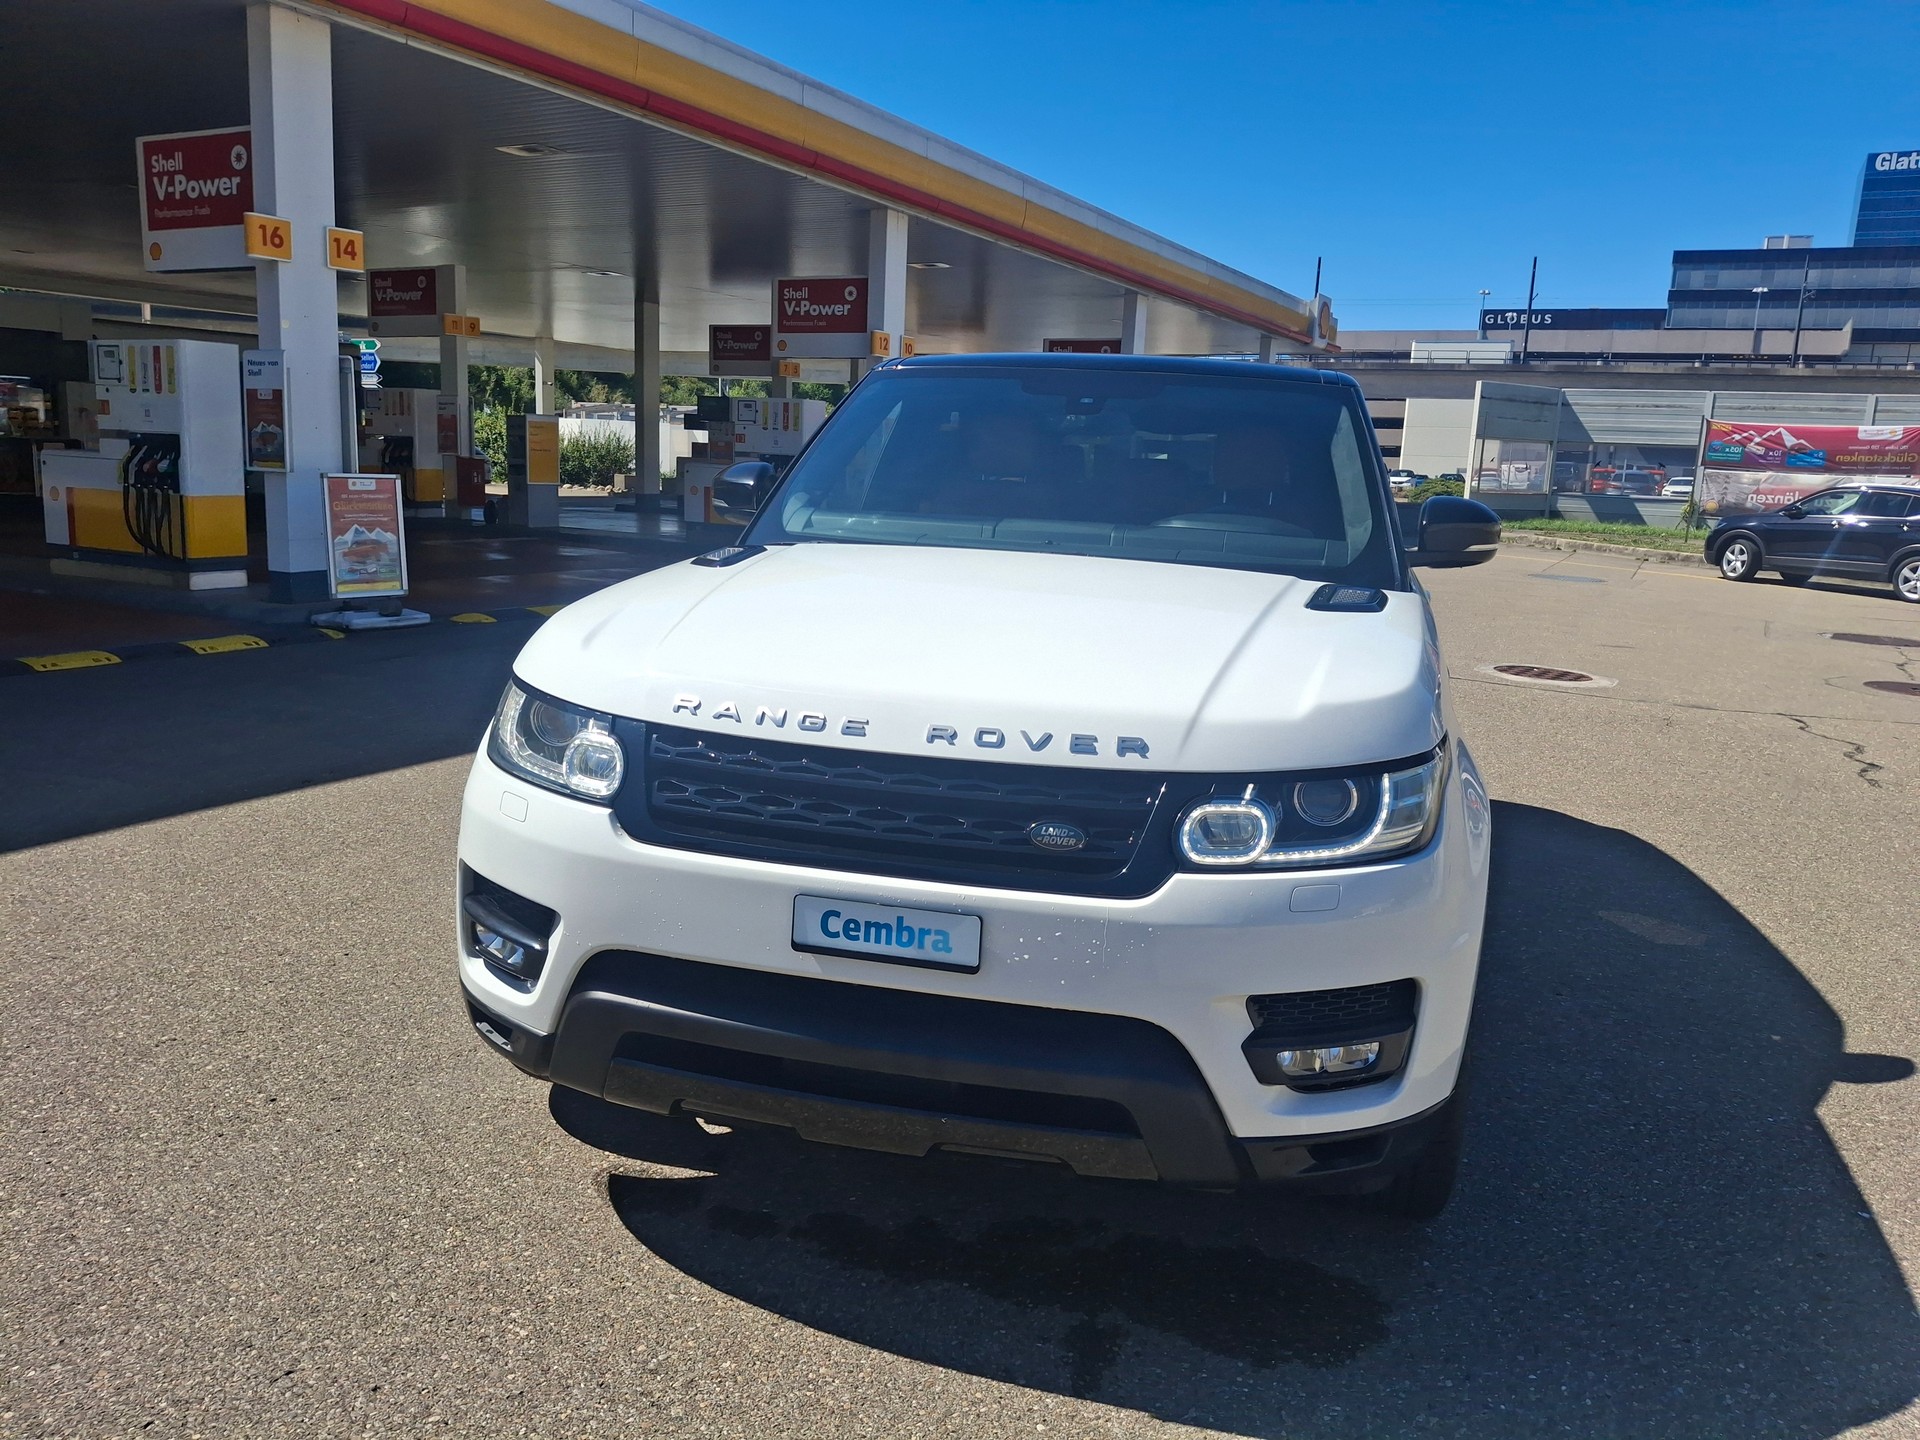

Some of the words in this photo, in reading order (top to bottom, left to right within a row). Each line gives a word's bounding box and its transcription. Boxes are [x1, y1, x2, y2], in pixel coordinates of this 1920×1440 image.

[151, 152, 183, 174] Shell
[1875, 152, 1920, 171] Glat
[152, 174, 241, 201] V-Power
[258, 223, 285, 249] 16
[332, 237, 358, 261] 14
[375, 288, 423, 301] V-Power
[783, 286, 809, 299] Shell
[783, 300, 852, 317] V-Power
[1485, 314, 1553, 324] GLOBUS
[469, 322, 476, 332] 9
[716, 339, 759, 350] V-Power
[878, 336, 889, 351] 12
[904, 343, 913, 355] 10
[672, 693, 870, 738] RANGE
[925, 724, 1151, 760] ROVER
[1041, 826, 1069, 837] LAND
[1042, 836, 1077, 847] ROVER
[819, 908, 953, 956] Cembra
